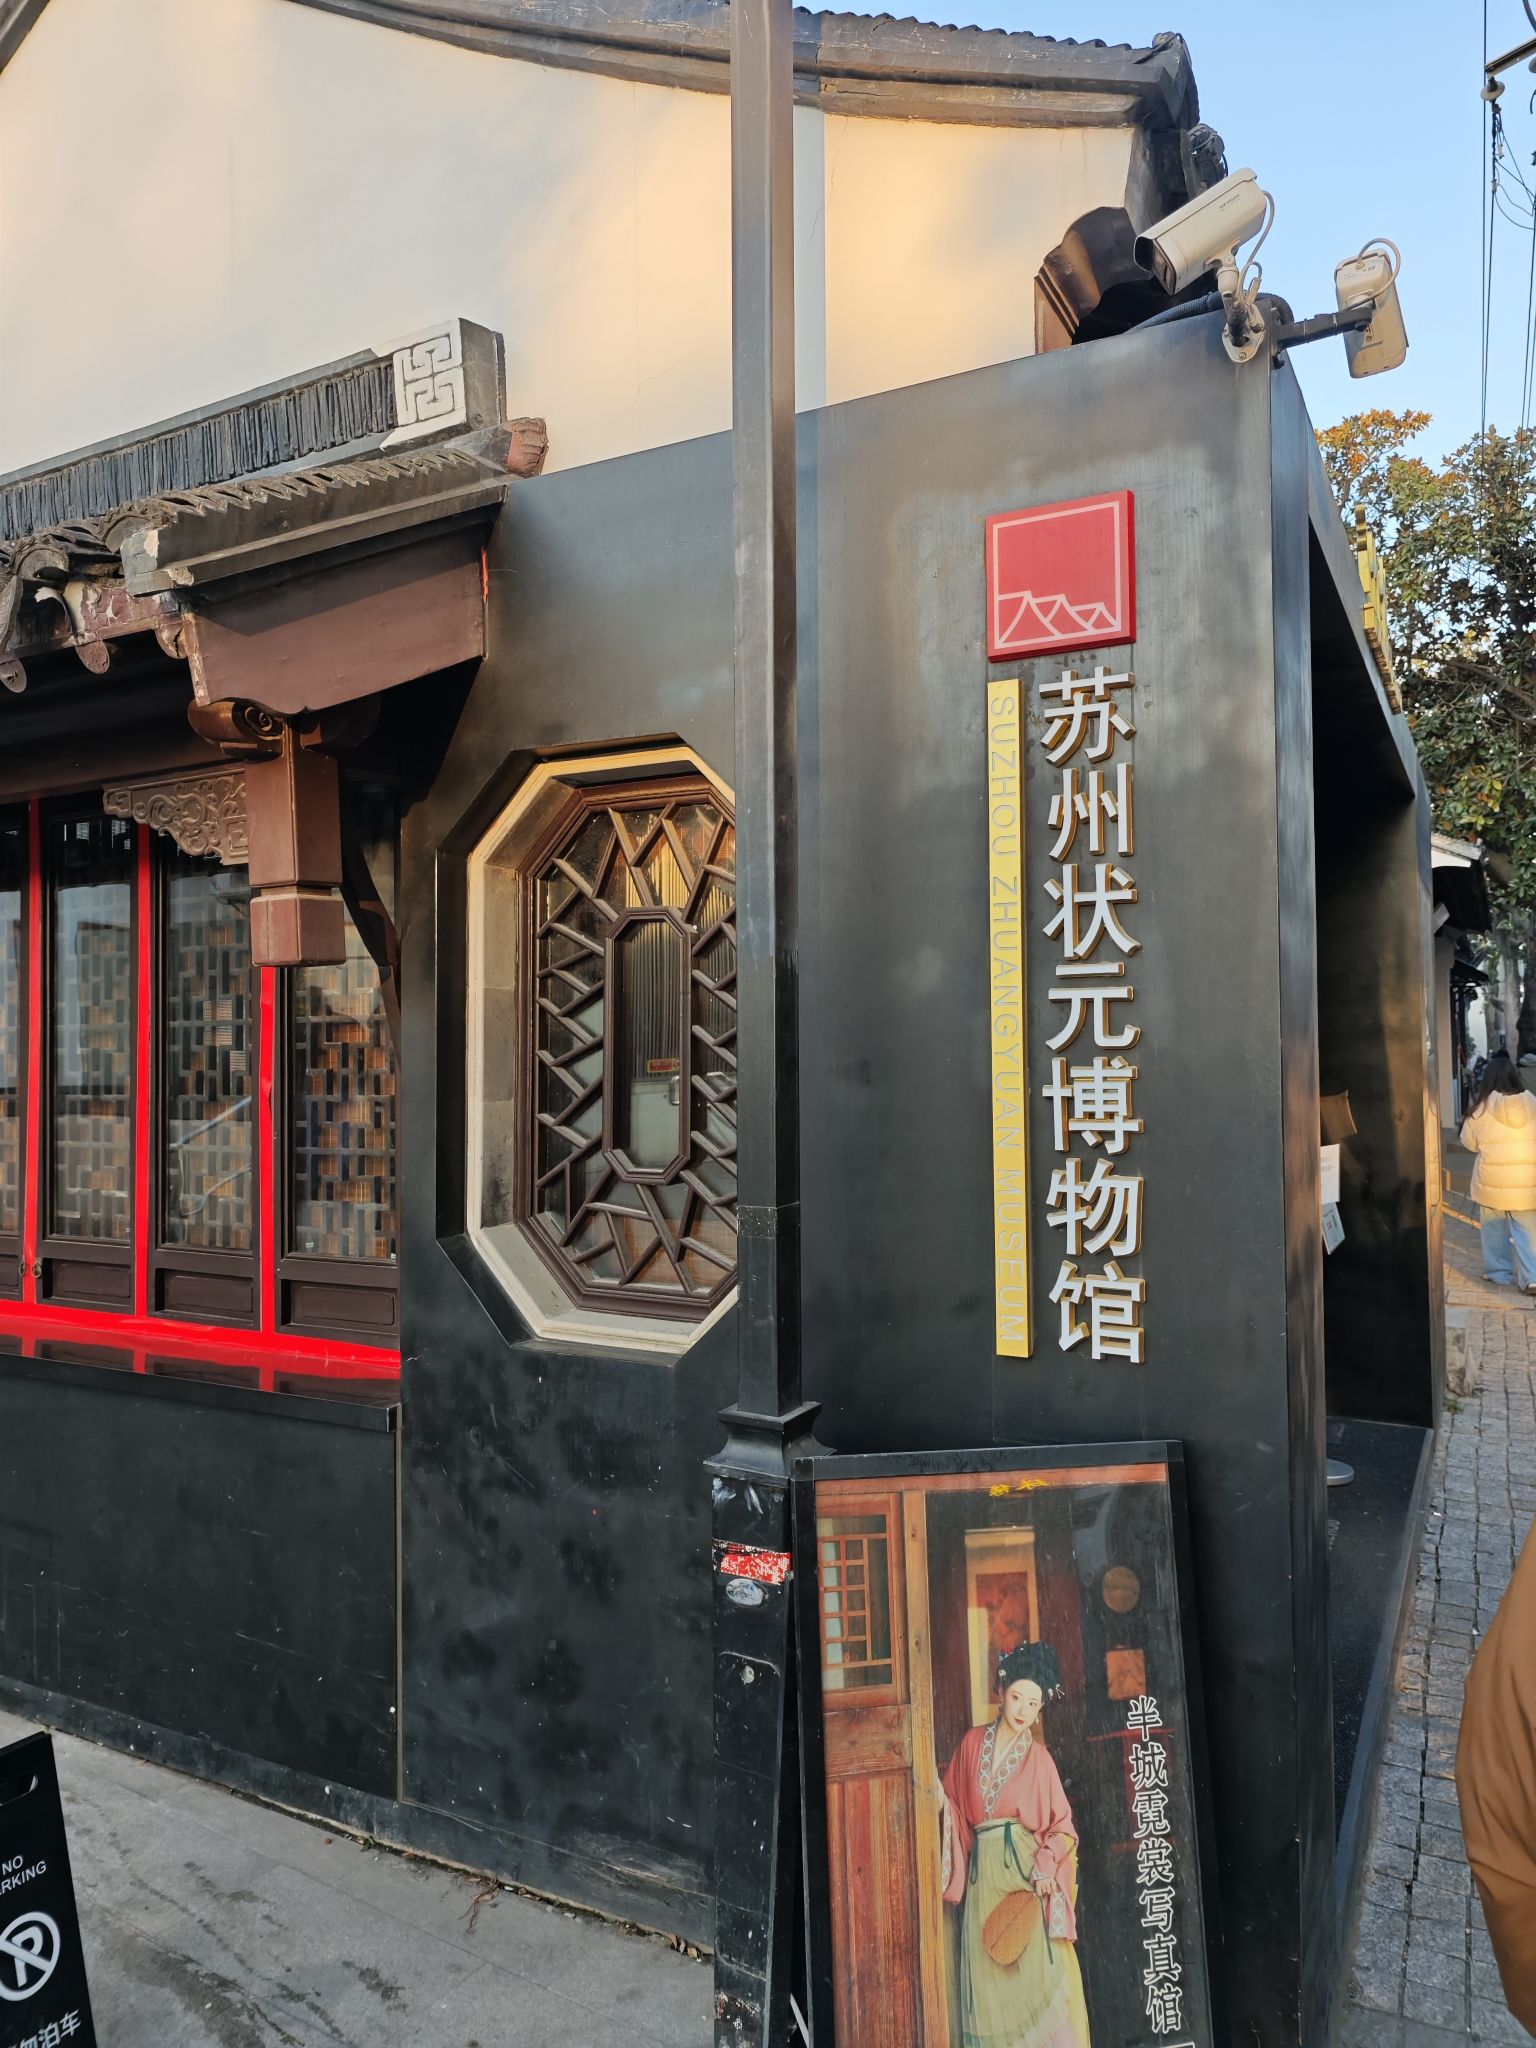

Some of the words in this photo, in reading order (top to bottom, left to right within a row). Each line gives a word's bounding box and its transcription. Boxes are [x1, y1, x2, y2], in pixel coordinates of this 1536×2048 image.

[990, 694, 1018, 857] SUZHOU
[993, 876, 1022, 1148] ZHUANGYUAN
[1038, 665, 1147, 1364] 苏州状元博物馆
[995, 1167, 1025, 1341] MUSEUM
[0, 1860, 48, 1896] RKING
[1, 1855, 24, 1876] NO
[1126, 1694, 1182, 2035] 半城霓裳写真馆
